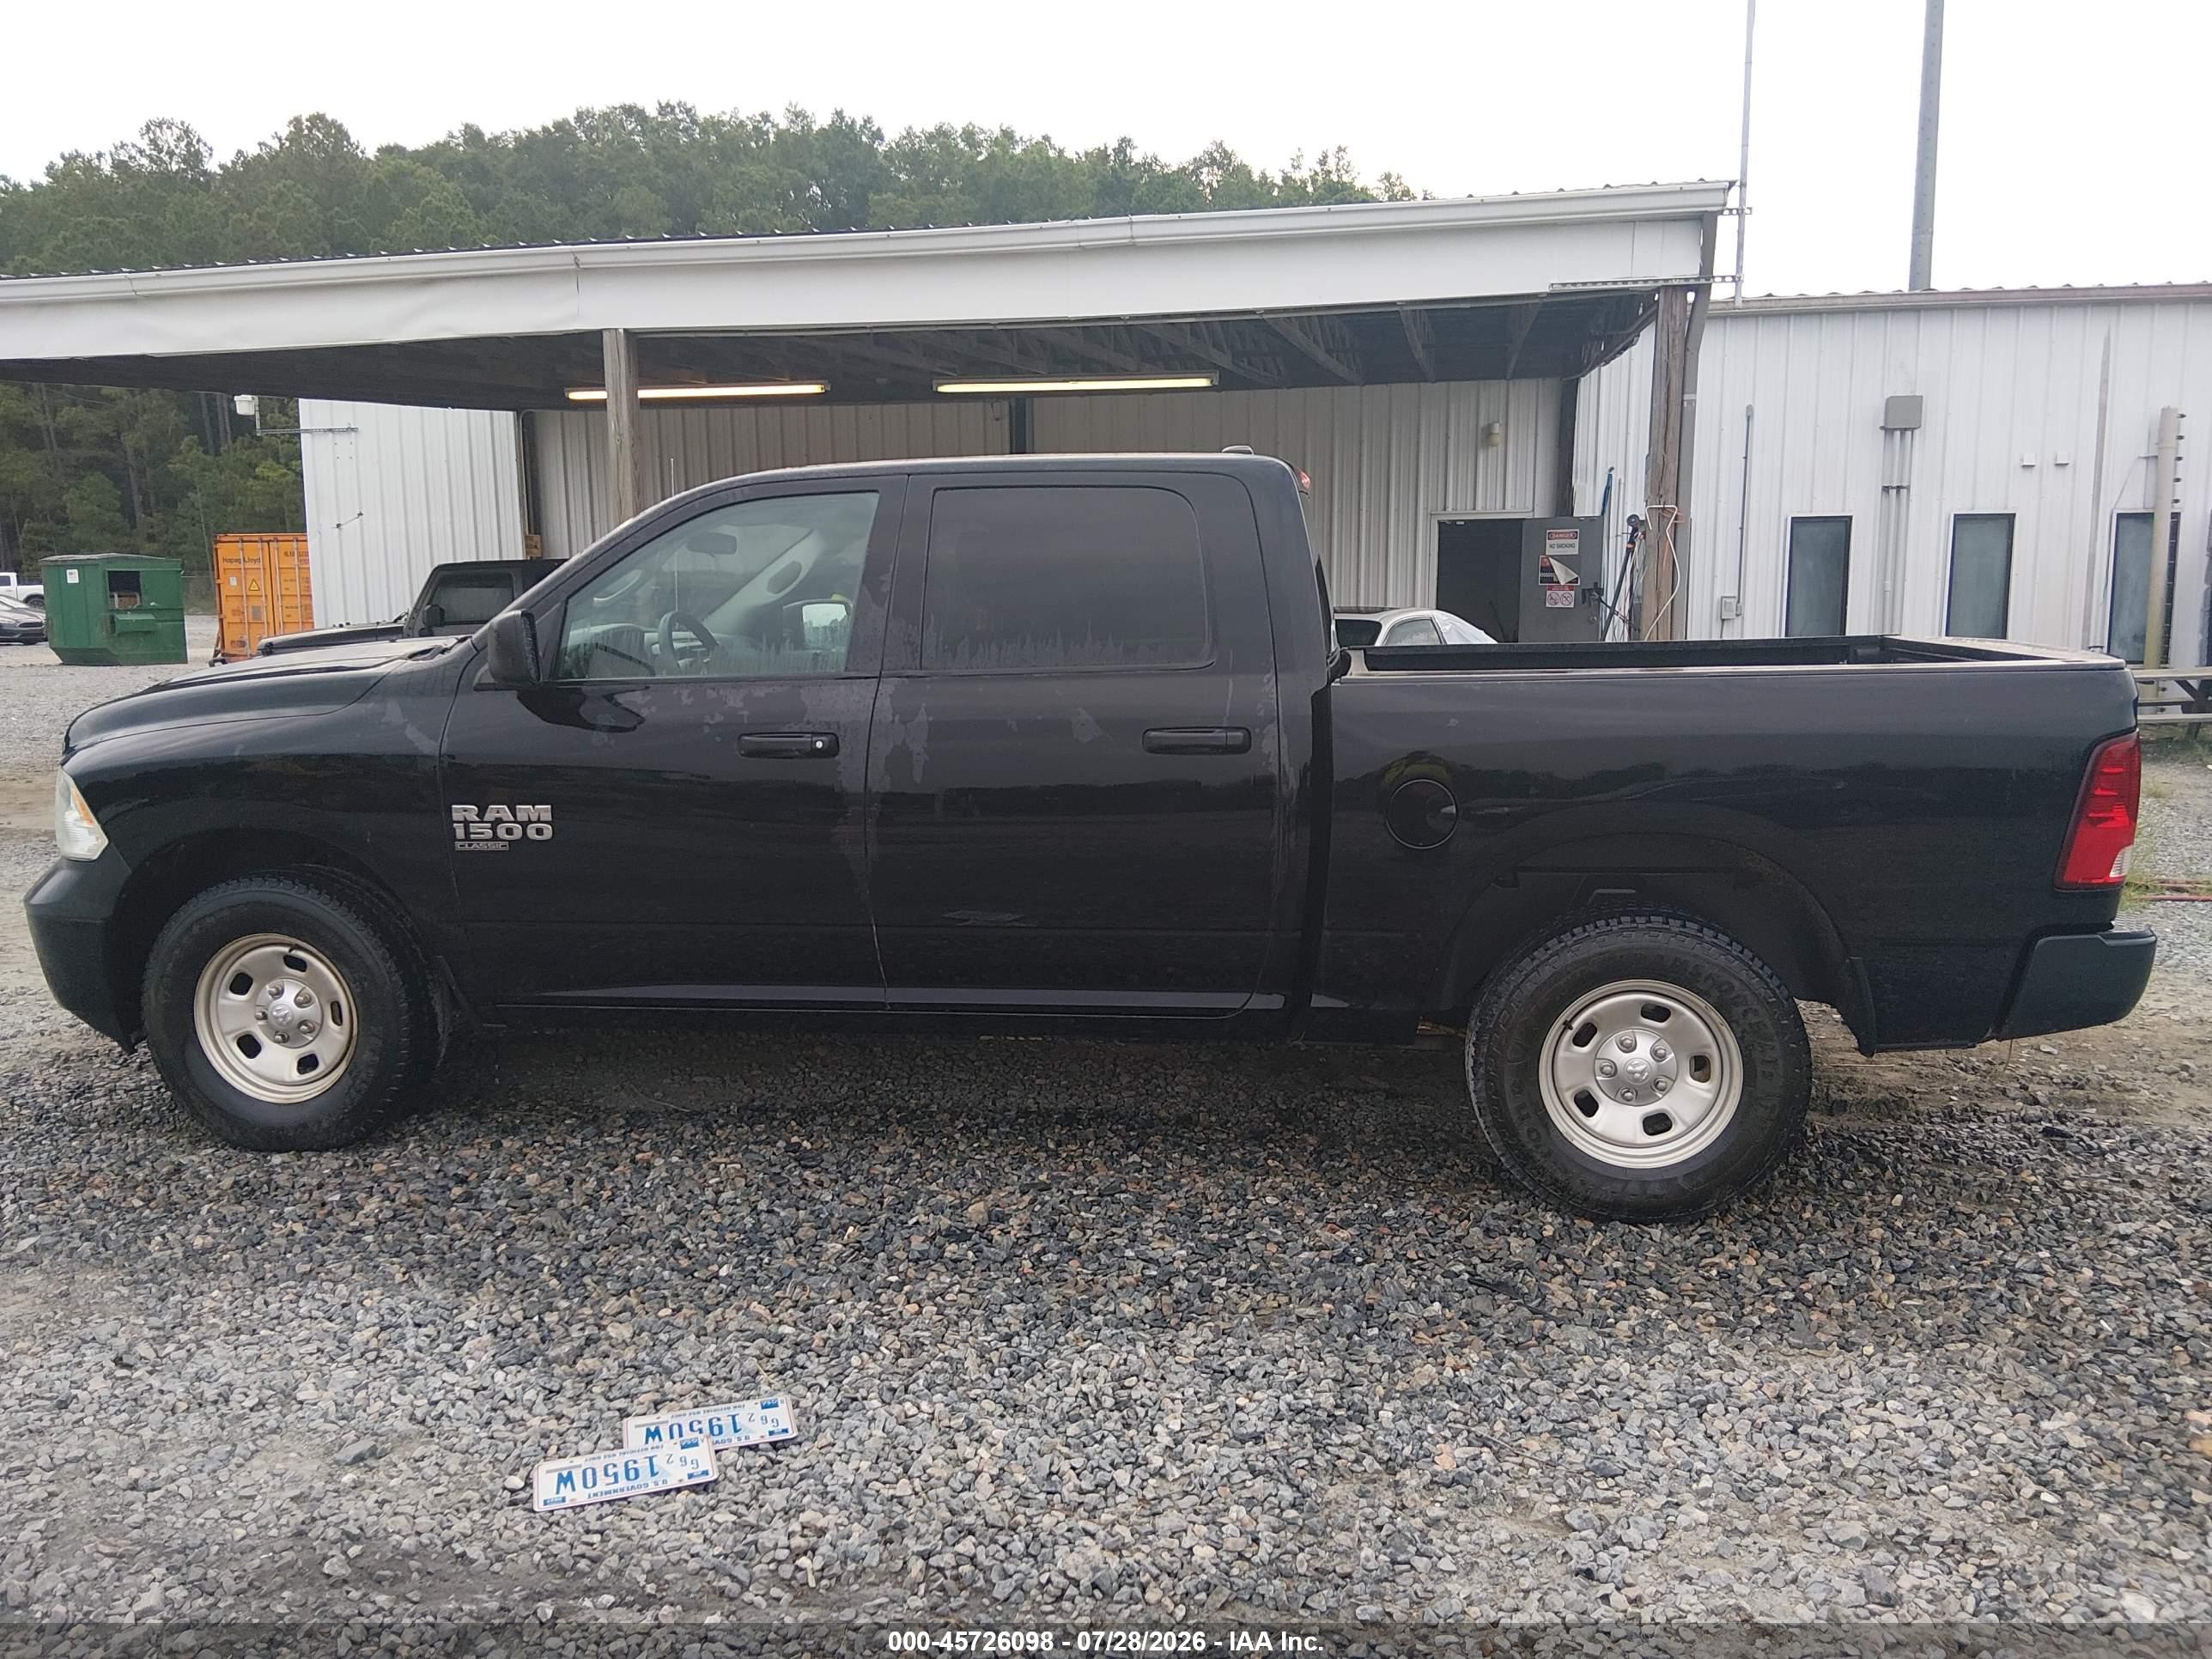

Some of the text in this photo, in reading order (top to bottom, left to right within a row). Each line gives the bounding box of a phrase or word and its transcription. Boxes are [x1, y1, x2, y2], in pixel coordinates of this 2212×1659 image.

[451, 805, 552, 822] RAM
[453, 823, 553, 841] 1500
[457, 842, 508, 850] CLASSIC
[556, 1455, 659, 1495] 1950W
[587, 1482, 649, 1498] GOVERNMENT
